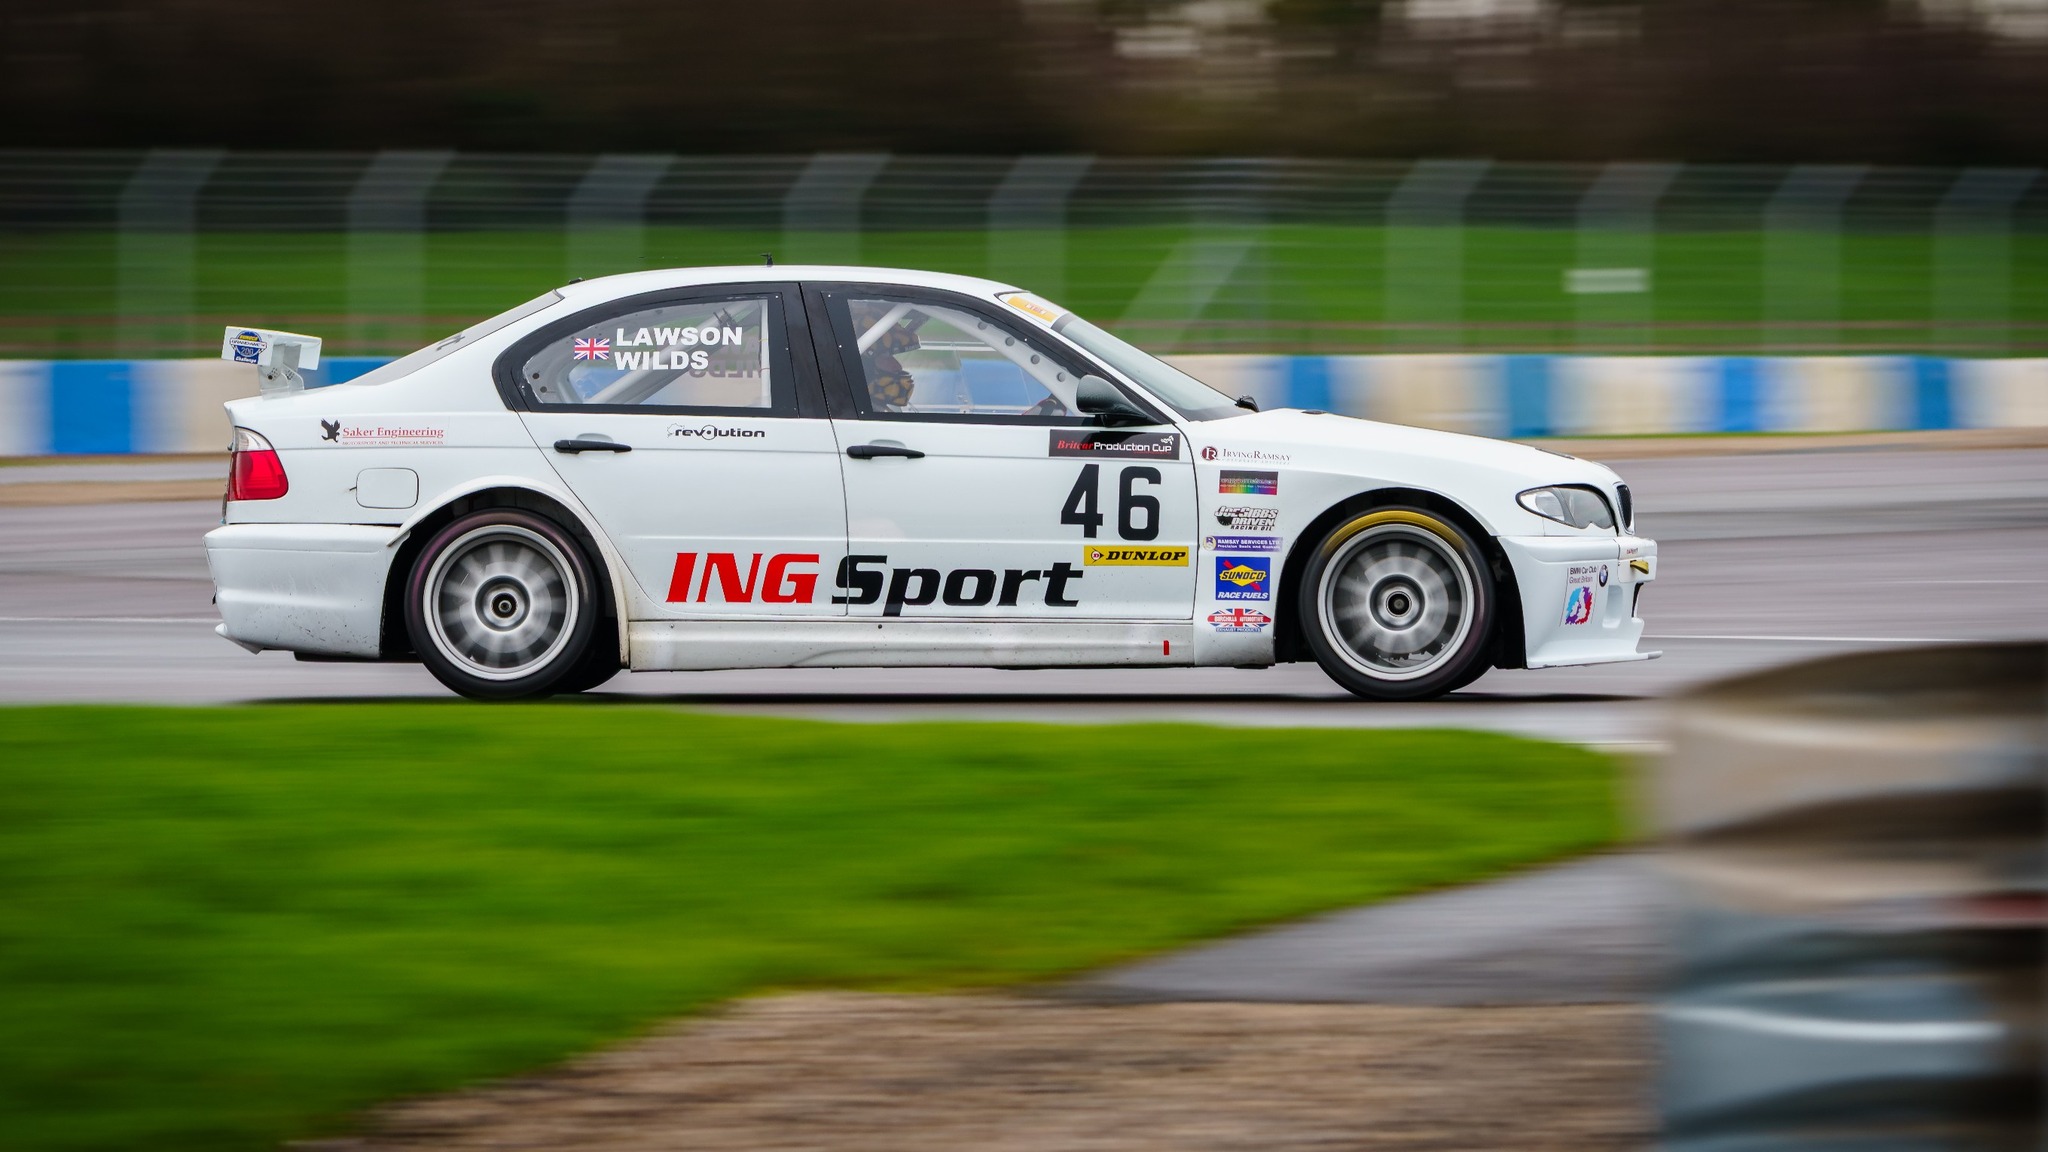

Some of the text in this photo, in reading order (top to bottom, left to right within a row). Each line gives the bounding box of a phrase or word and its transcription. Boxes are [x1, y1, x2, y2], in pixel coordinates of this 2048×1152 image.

[616, 326, 743, 346] LAWSON
[614, 350, 709, 371] WILDS
[343, 427, 444, 438] Saker Engineering
[675, 426, 766, 440] revolution
[1057, 440, 1172, 452] Britcar Production Cup
[1060, 463, 1162, 541] 46
[1231, 517, 1275, 527] DRIVEN
[1105, 551, 1186, 561] DUNLOP
[1221, 571, 1264, 580] SUNOCO
[1569, 567, 1581, 575] BMW
[665, 552, 1084, 617] ING Sport
[1217, 591, 1242, 599] RACE
